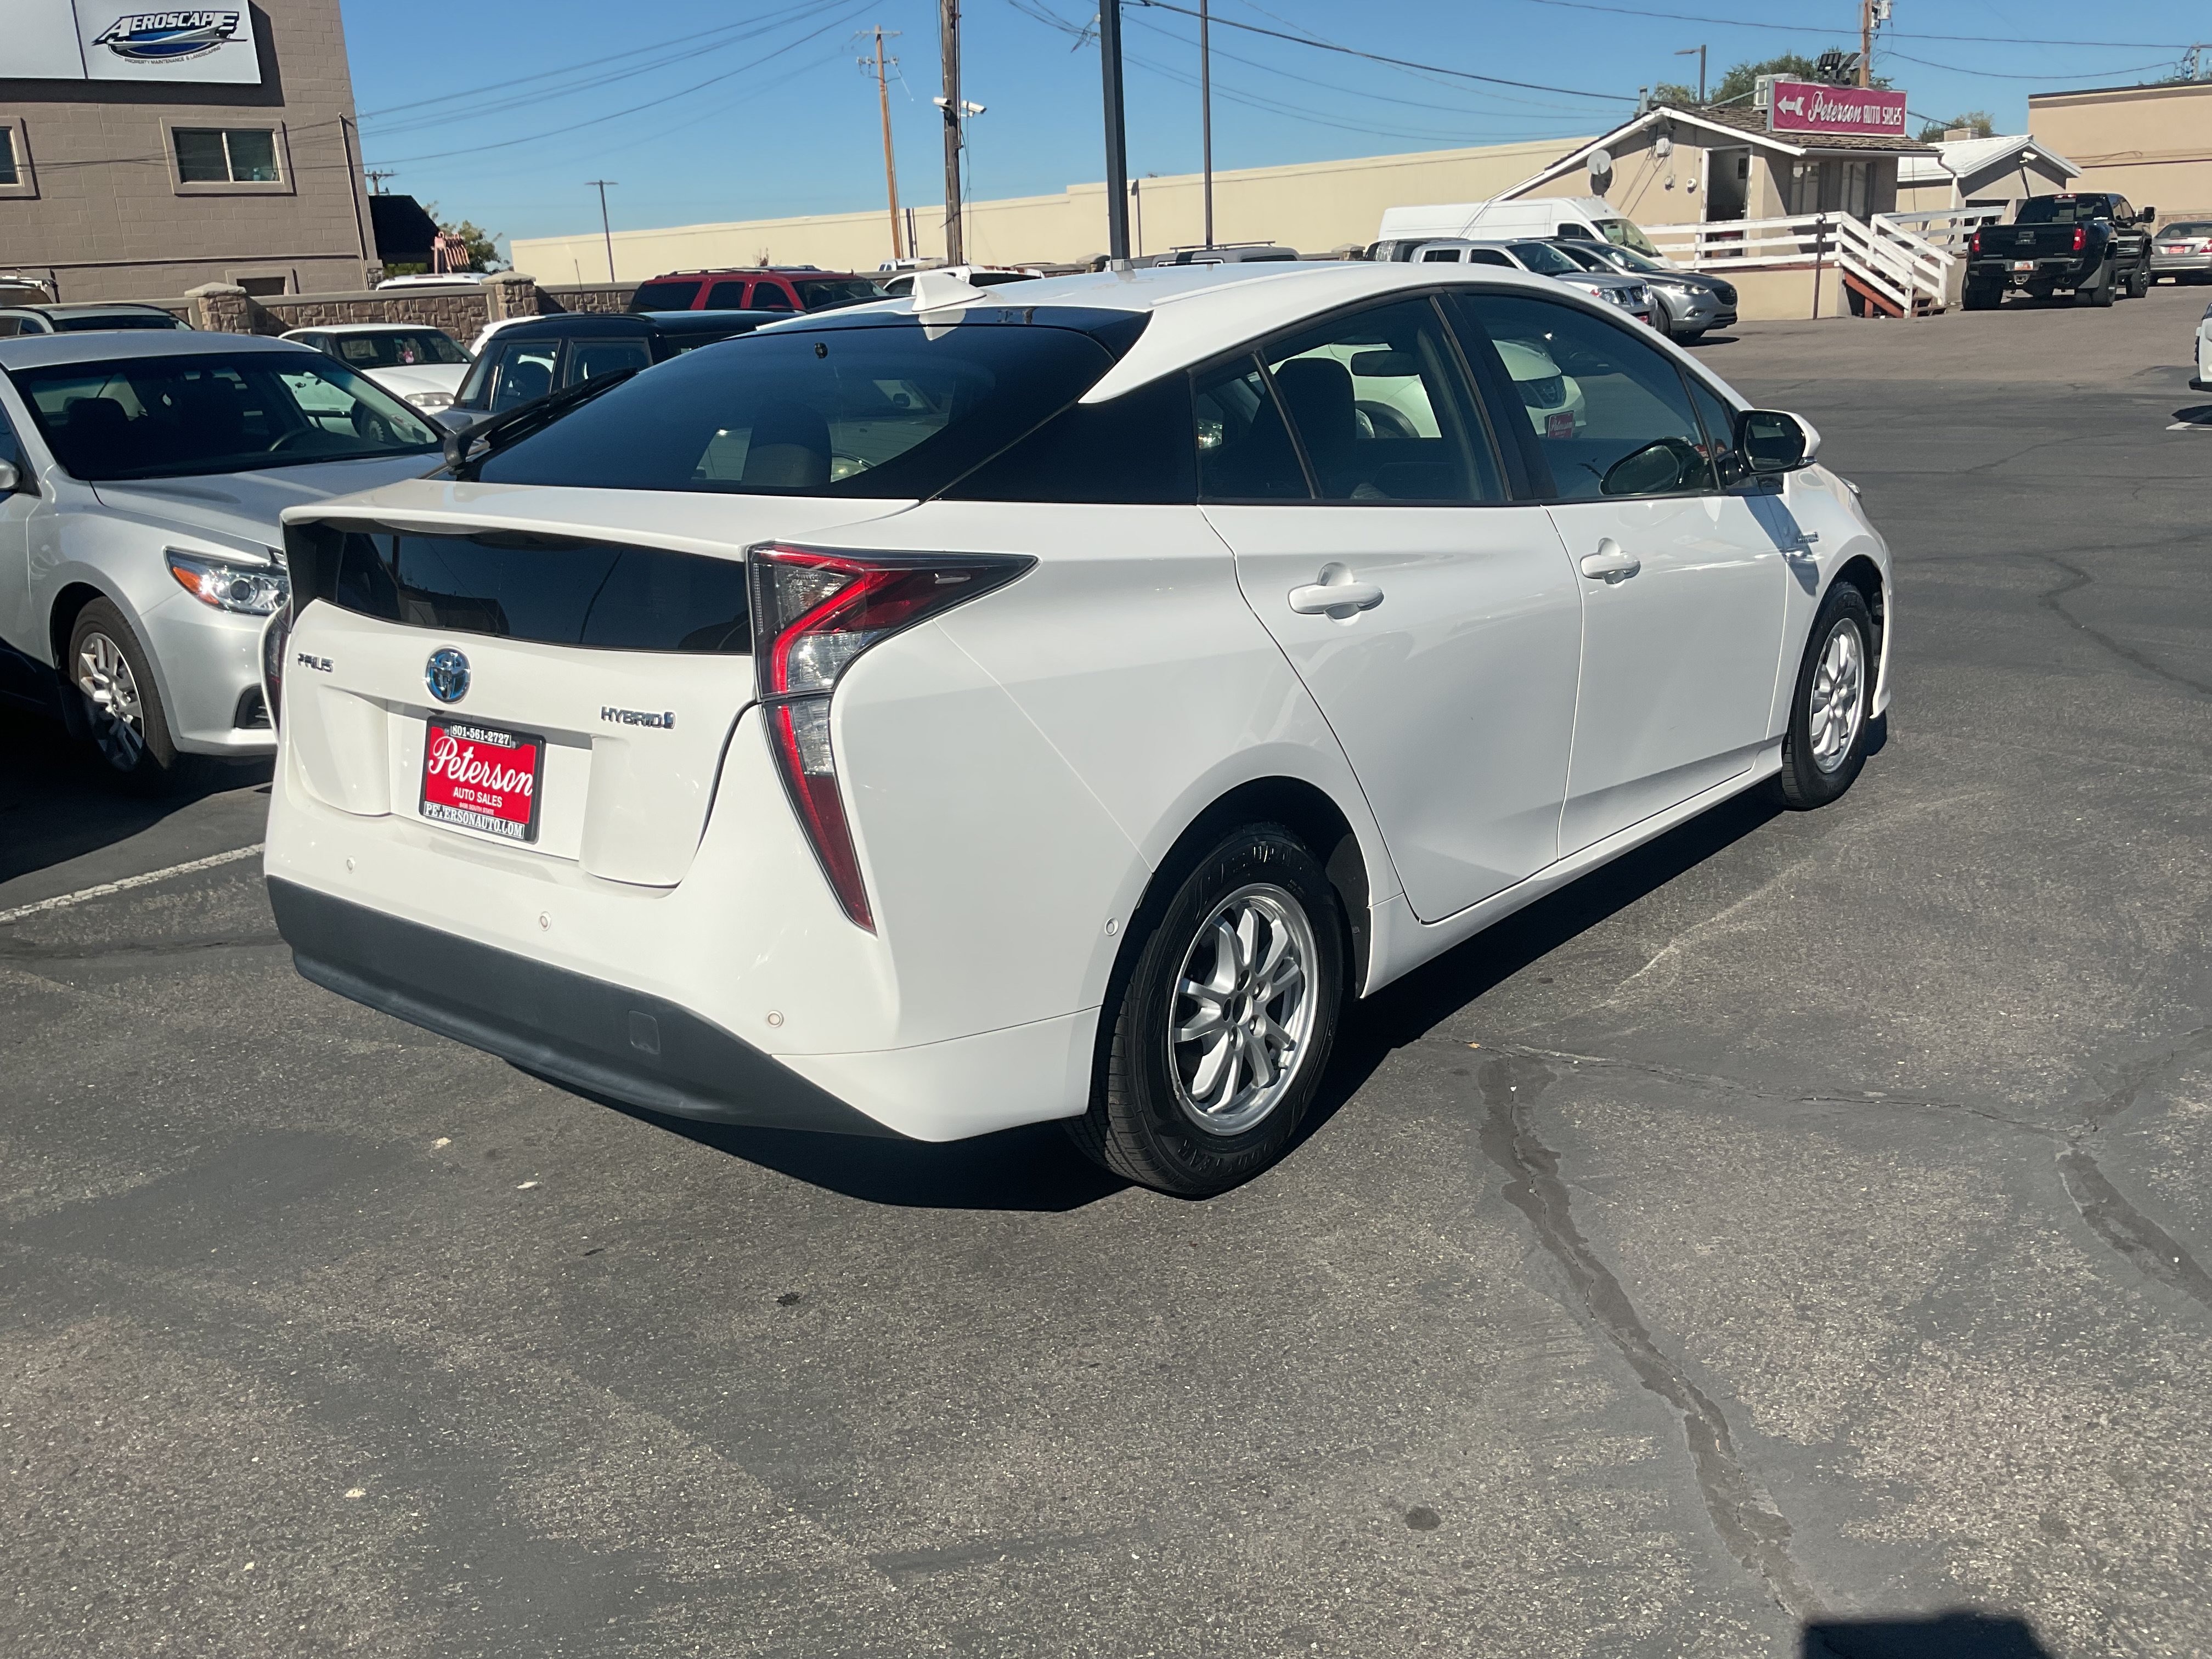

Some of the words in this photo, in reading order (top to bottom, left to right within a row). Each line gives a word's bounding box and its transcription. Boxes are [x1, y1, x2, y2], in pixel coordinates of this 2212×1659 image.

[93, 11, 240, 41] AEROSCAPE
[1808, 91, 1863, 123] Peterson
[1863, 105, 1881, 125] AUTO
[1882, 106, 1902, 126] SALES
[601, 706, 663, 728] HYBRID
[452, 725, 510, 744] 801-561-2727
[428, 736, 533, 797] Peterson
[453, 787, 475, 801] AUTO
[477, 792, 503, 808] SALES
